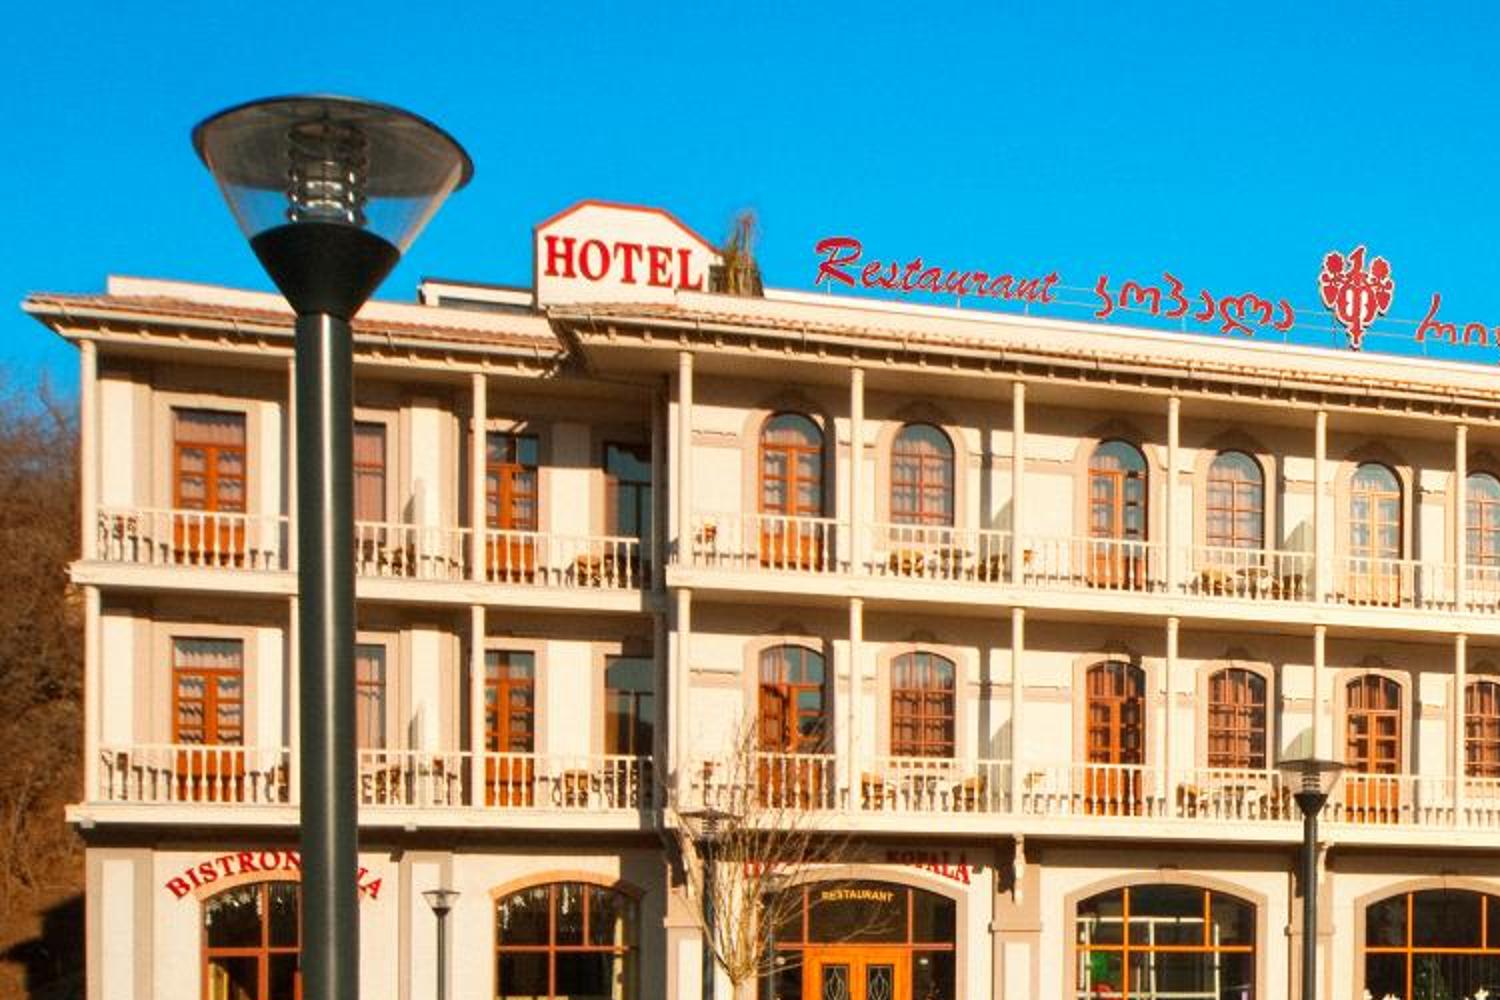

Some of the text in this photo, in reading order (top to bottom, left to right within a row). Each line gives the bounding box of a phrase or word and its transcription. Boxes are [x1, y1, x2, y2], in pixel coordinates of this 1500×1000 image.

[544, 234, 703, 291] HOTEL
[815, 236, 1058, 303] Restaurant
[821, 889, 895, 902] RESTAURANT
